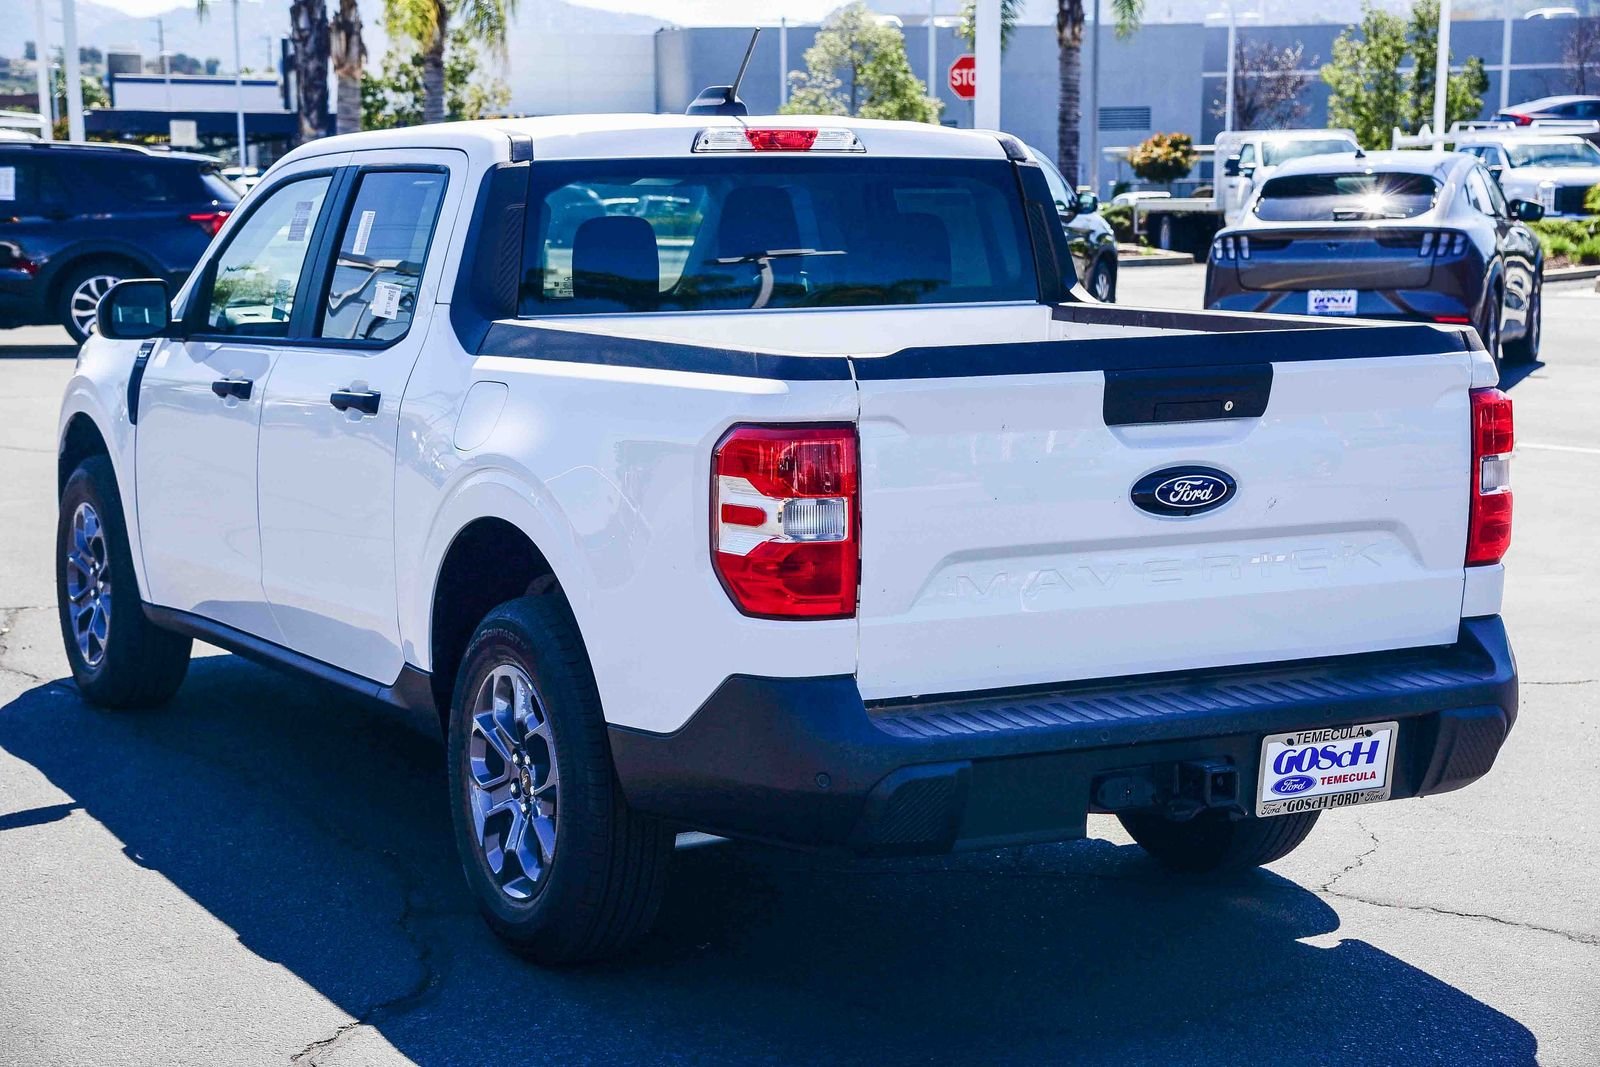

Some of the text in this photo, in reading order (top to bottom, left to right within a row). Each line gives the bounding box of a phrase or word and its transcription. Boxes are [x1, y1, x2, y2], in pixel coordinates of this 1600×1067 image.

[952, 68, 976, 87] STO
[1169, 480, 1214, 502] Ford
[947, 542, 1383, 601] MAVERICK
[1296, 726, 1365, 745] TEMECULA
[1280, 778, 1307, 792] Ford
[1320, 770, 1377, 786] TEMECULA
[1260, 803, 1282, 815] Ford
[1330, 792, 1360, 807] FORD
[1364, 790, 1385, 802] Ford
